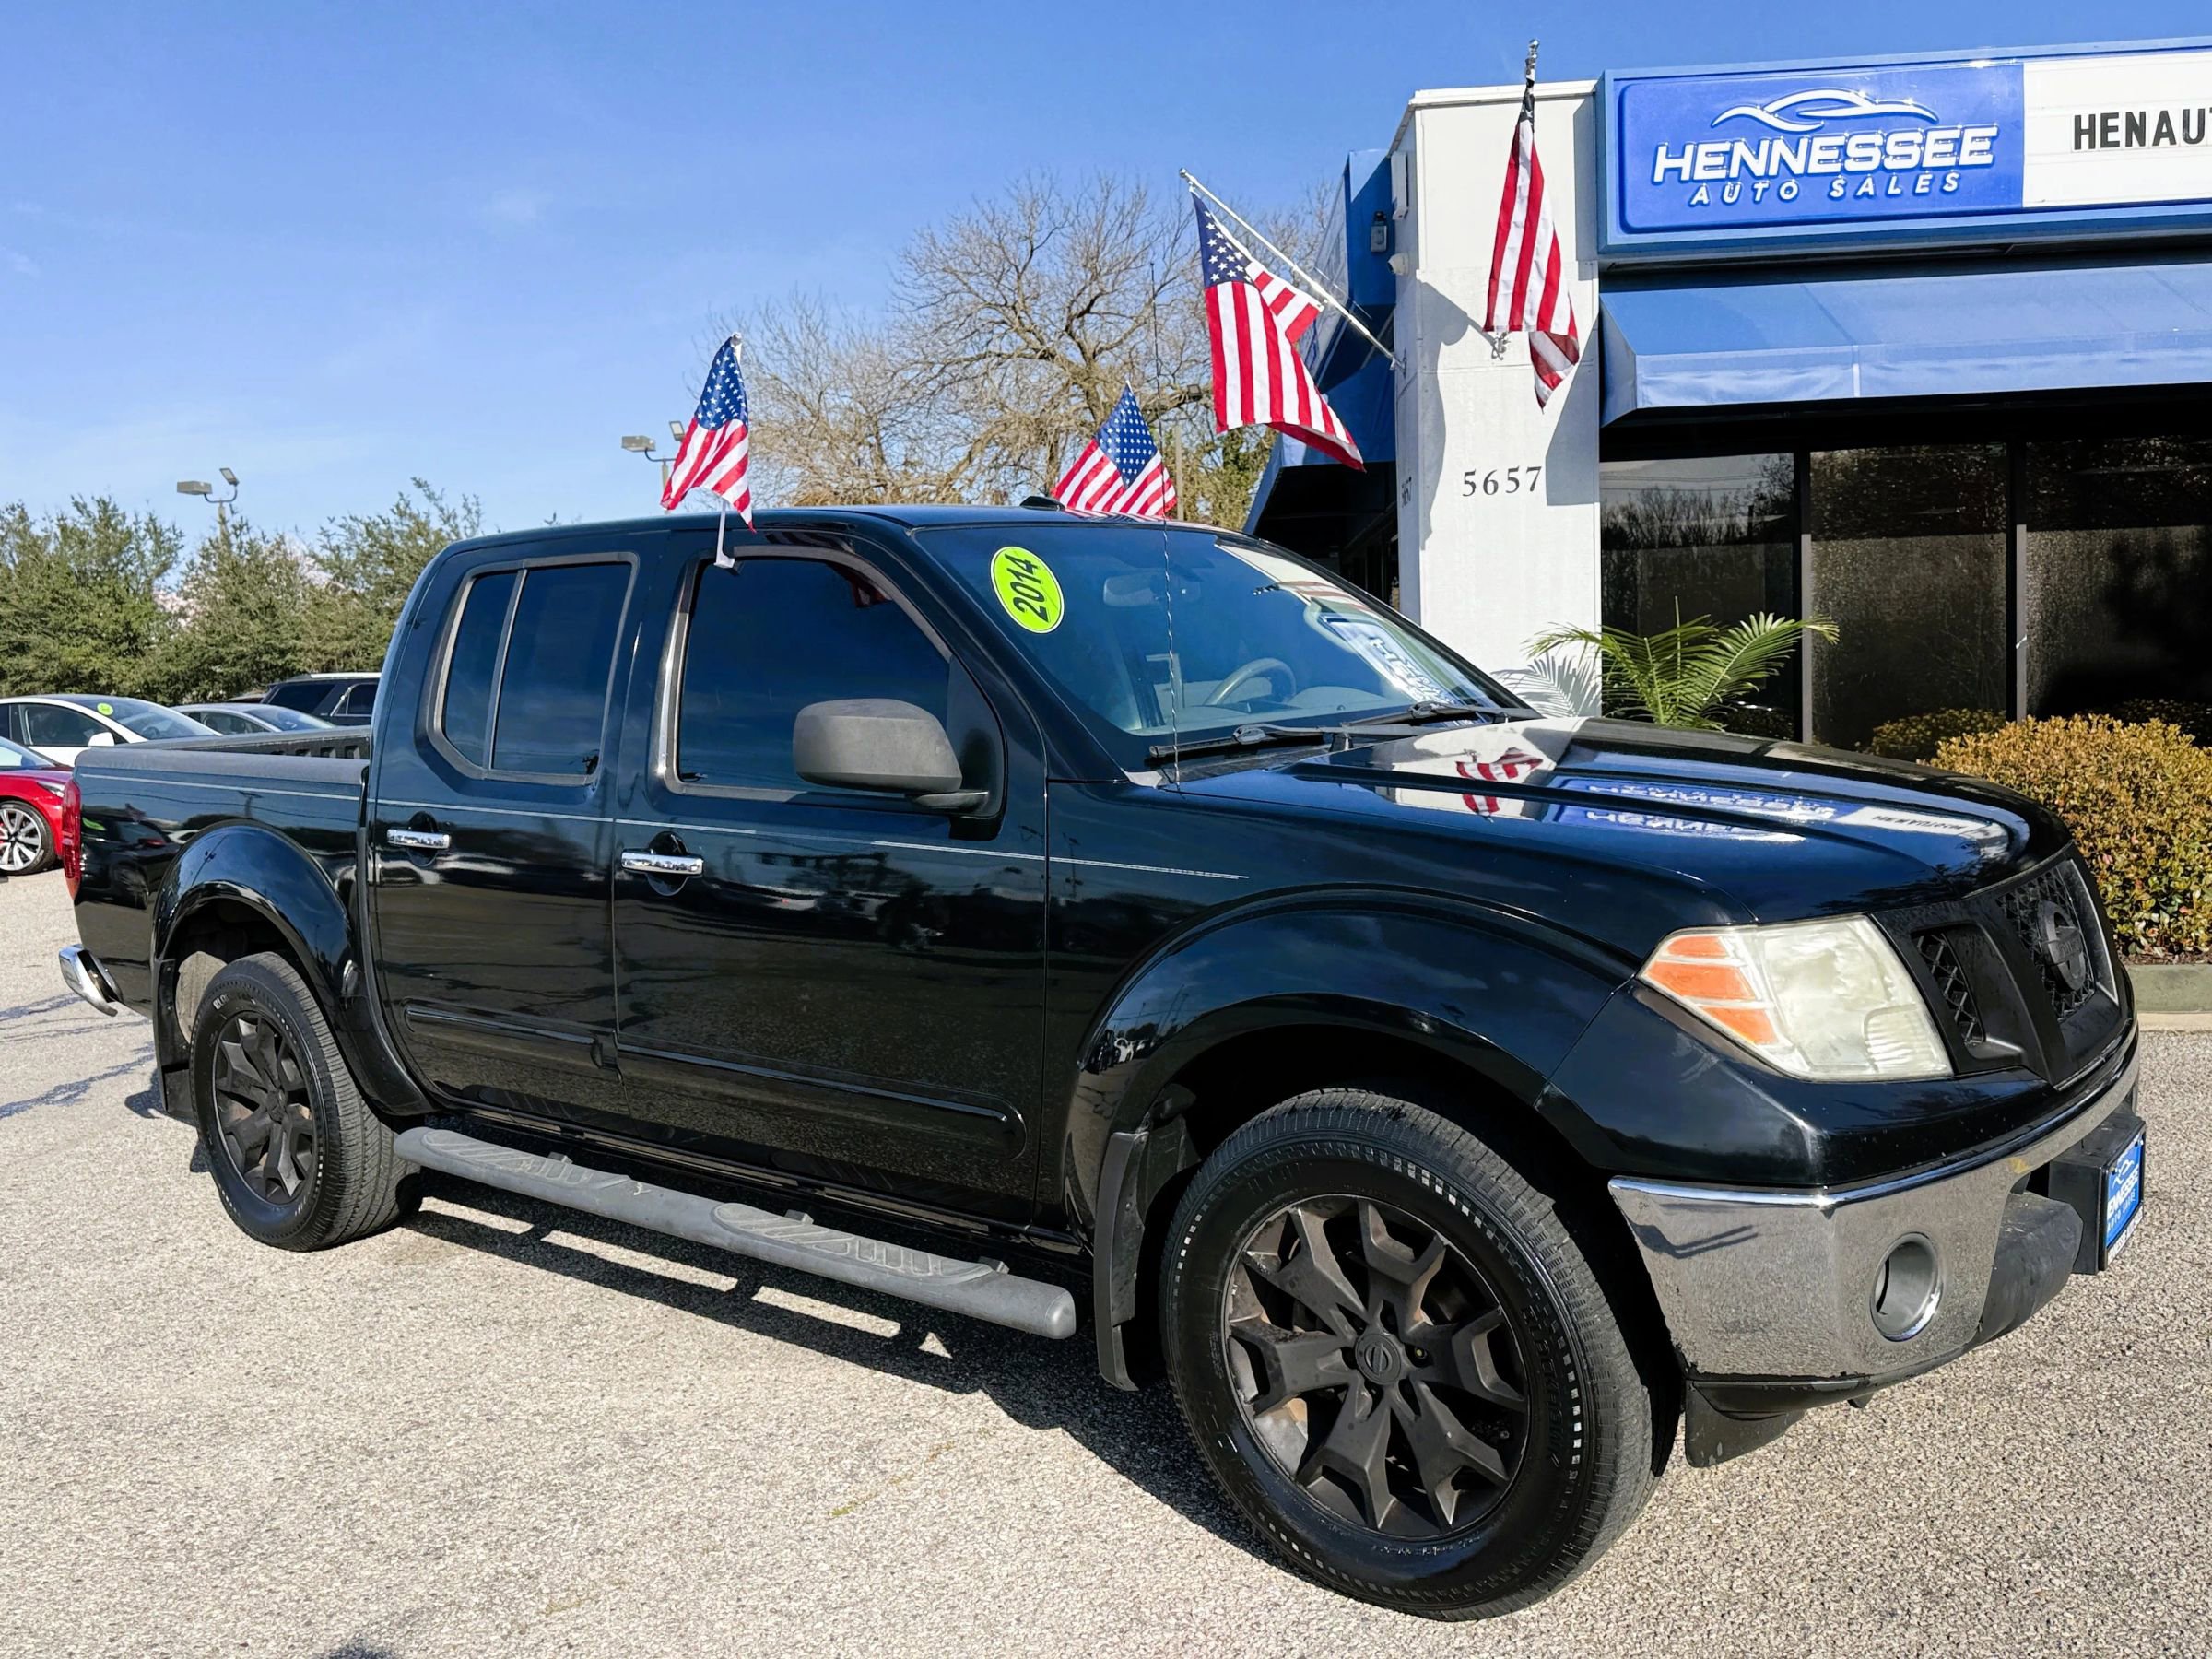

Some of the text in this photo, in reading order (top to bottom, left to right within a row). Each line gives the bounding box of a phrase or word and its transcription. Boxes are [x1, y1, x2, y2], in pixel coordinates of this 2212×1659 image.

[2074, 107, 2212, 150] HENAU
[1653, 124, 1998, 182] HENNESSEE
[1690, 171, 1960, 206] AUTO SALES
[1462, 465, 1542, 497] 5657
[1005, 553, 1049, 623] 2014
